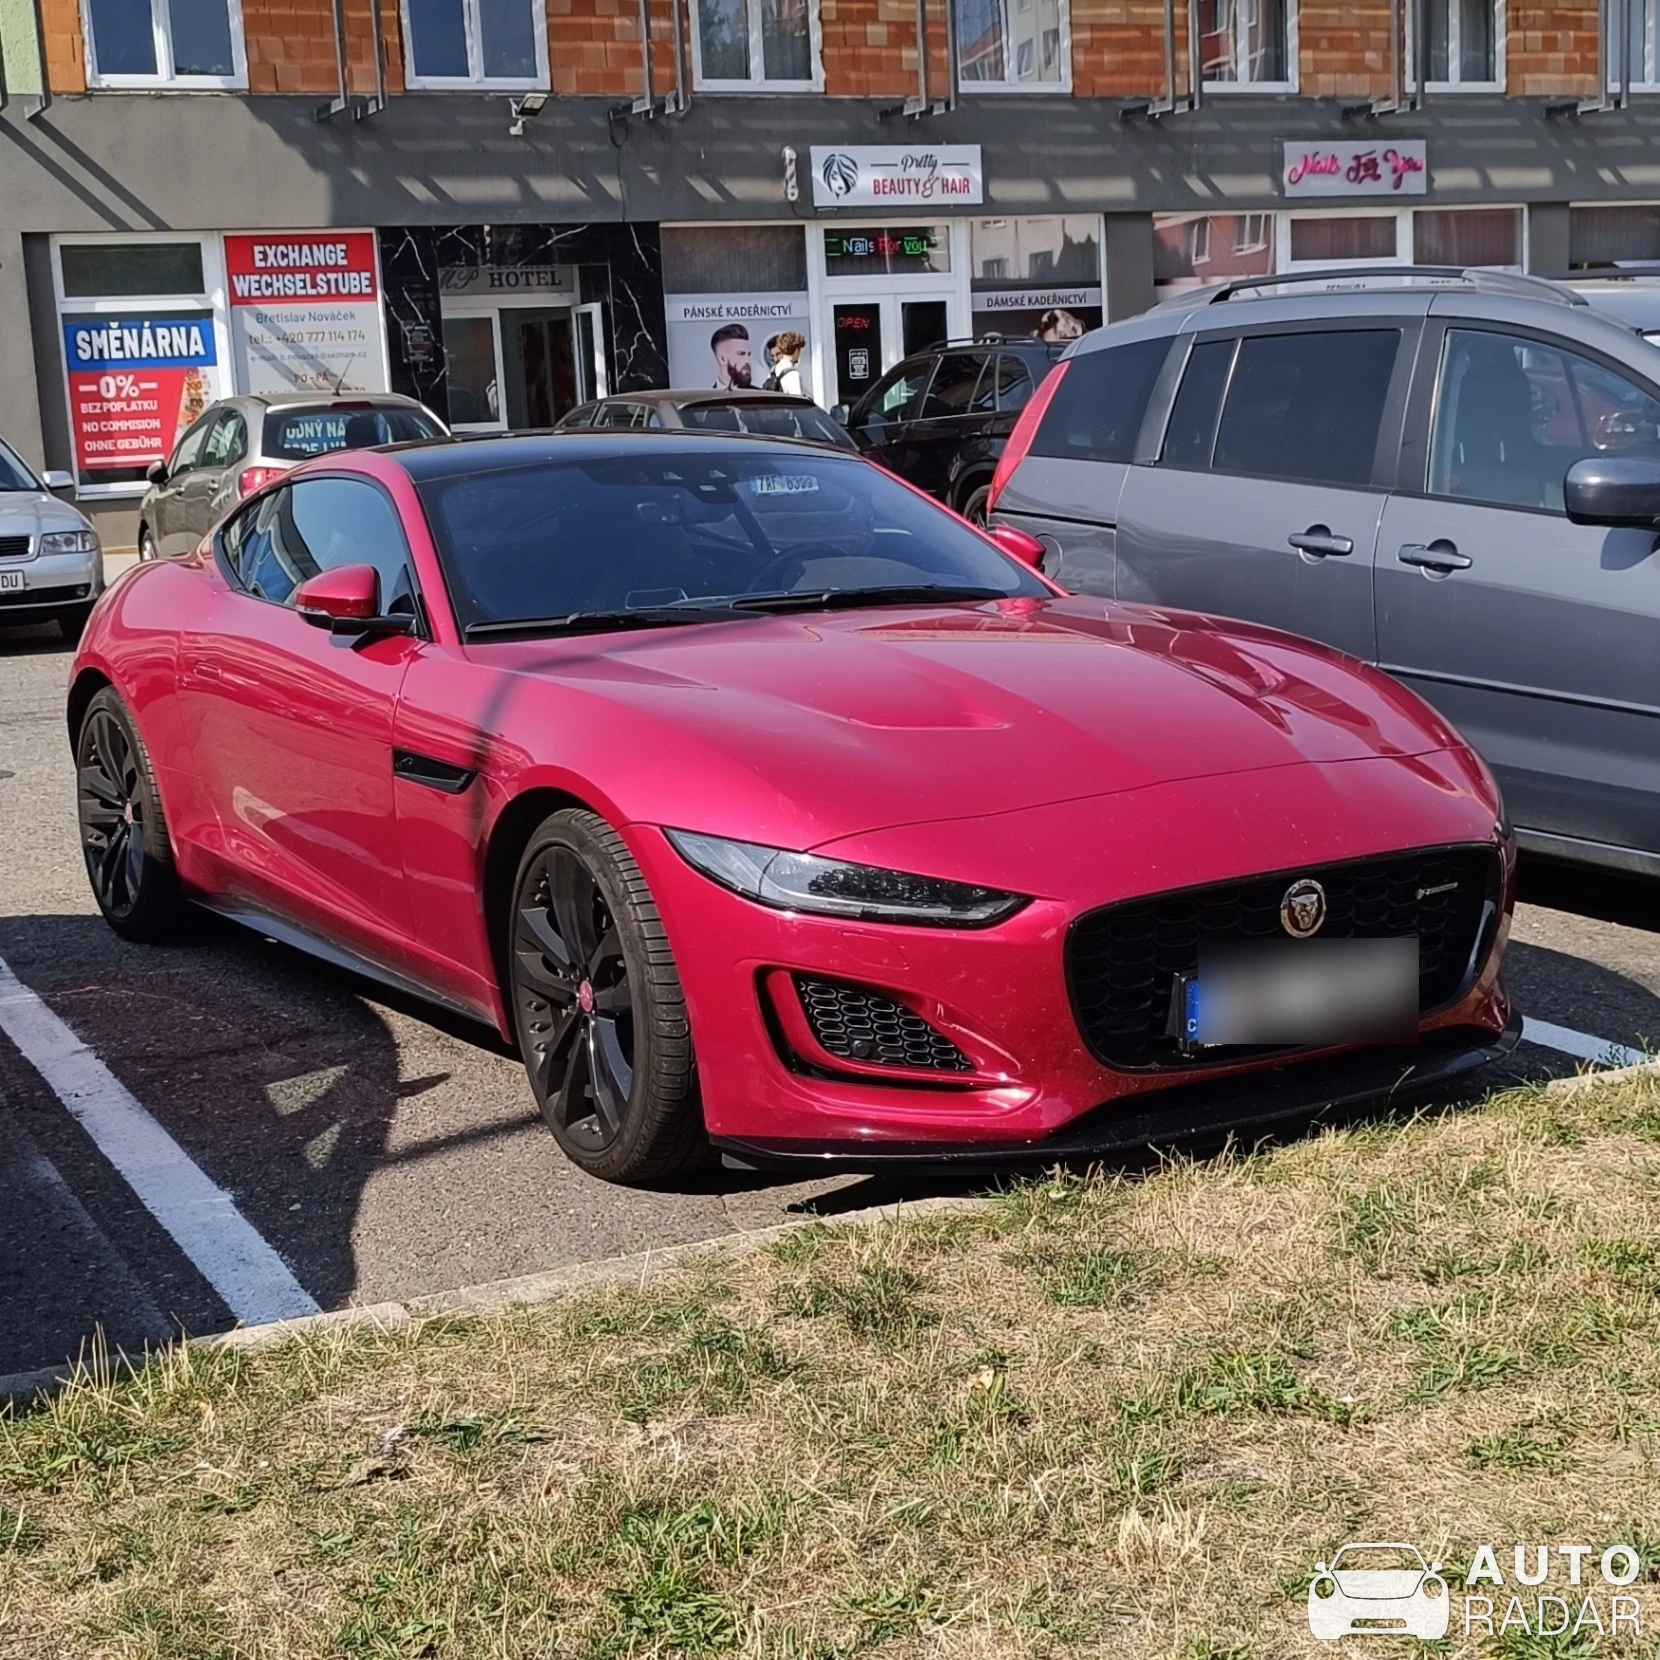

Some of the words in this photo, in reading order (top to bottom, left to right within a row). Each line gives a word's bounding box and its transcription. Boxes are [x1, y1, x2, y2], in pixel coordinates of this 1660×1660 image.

[901, 153, 938, 174] Pretty
[873, 178, 921, 195] BEAUTY
[941, 177, 970, 194] HAIR
[253, 243, 348, 268] EXCHANGE
[232, 271, 372, 297] WECHSELSTUBE
[488, 270, 562, 288] HOTEL
[986, 294, 1026, 308] DÁMSKÉ
[683, 304, 724, 318] PÁNSKÉ
[726, 302, 792, 317] KADEŘNICTVÍ
[837, 316, 870, 329] OPEN
[76, 321, 206, 361] SMĚNÁRNA
[306, 331, 325, 343] 777
[99, 374, 140, 399] 0%
[80, 402, 102, 414] BEZ
[103, 400, 158, 412] POPLATKU
[82, 421, 99, 433] NO
[84, 440, 116, 452] OHNE
[117, 435, 162, 450] GEBÜHR
